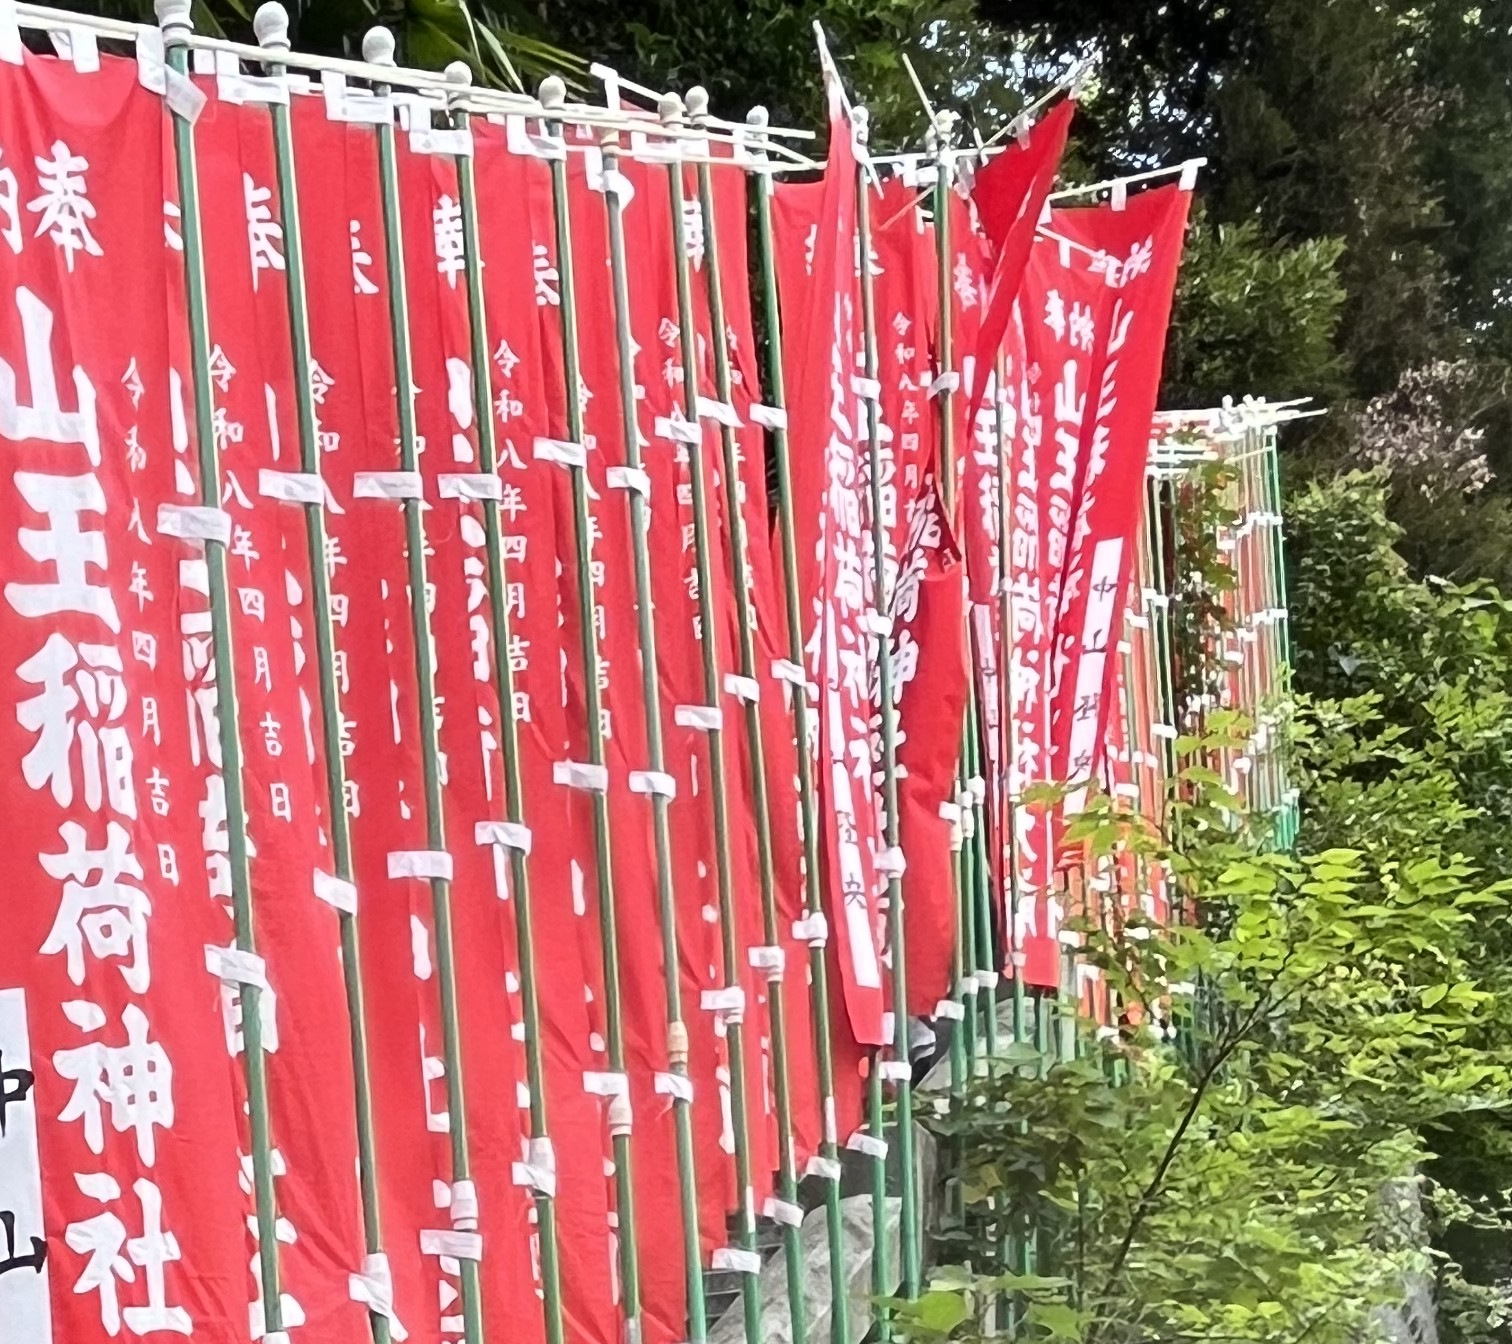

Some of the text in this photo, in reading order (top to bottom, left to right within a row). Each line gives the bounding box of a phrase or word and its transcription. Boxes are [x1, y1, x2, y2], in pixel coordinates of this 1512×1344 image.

[121, 357, 180, 887] 令和八年四月吉日
[209, 343, 293, 822] 令和八年四月吉日
[493, 339, 531, 722] 令和八年四月吉日
